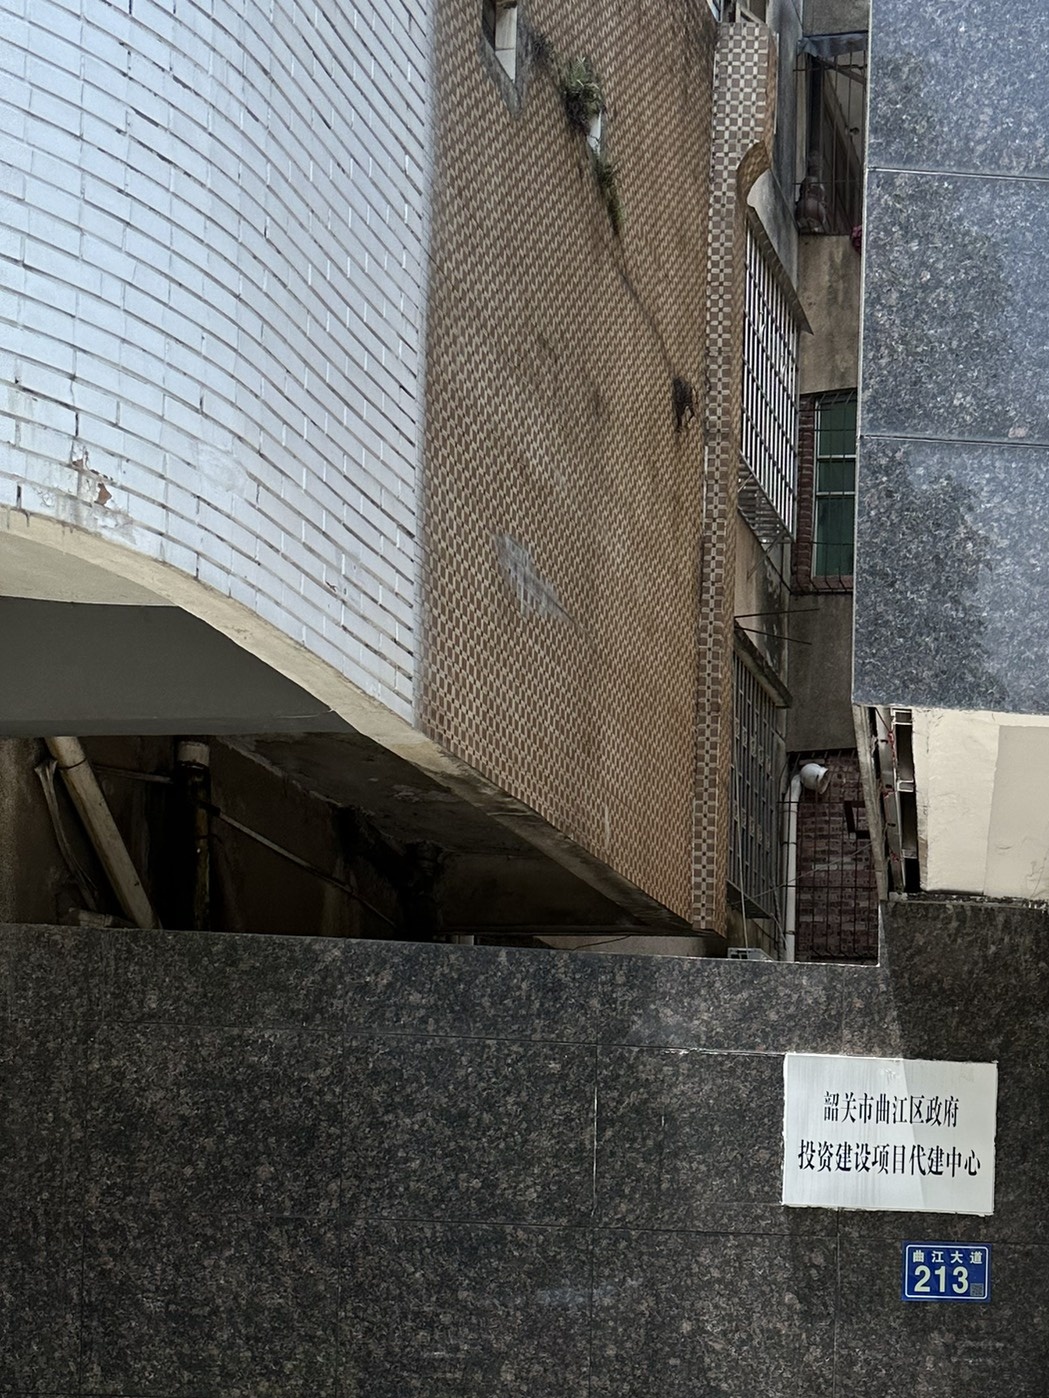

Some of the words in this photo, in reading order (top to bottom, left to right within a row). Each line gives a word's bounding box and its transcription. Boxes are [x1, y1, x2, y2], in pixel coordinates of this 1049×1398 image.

[823, 1090, 960, 1128] 韶关市曲江区政府
[797, 1139, 982, 1178] 投资建设项目代建中心
[912, 1249, 983, 1265] 曲江大道
[913, 1264, 969, 1294] 213
